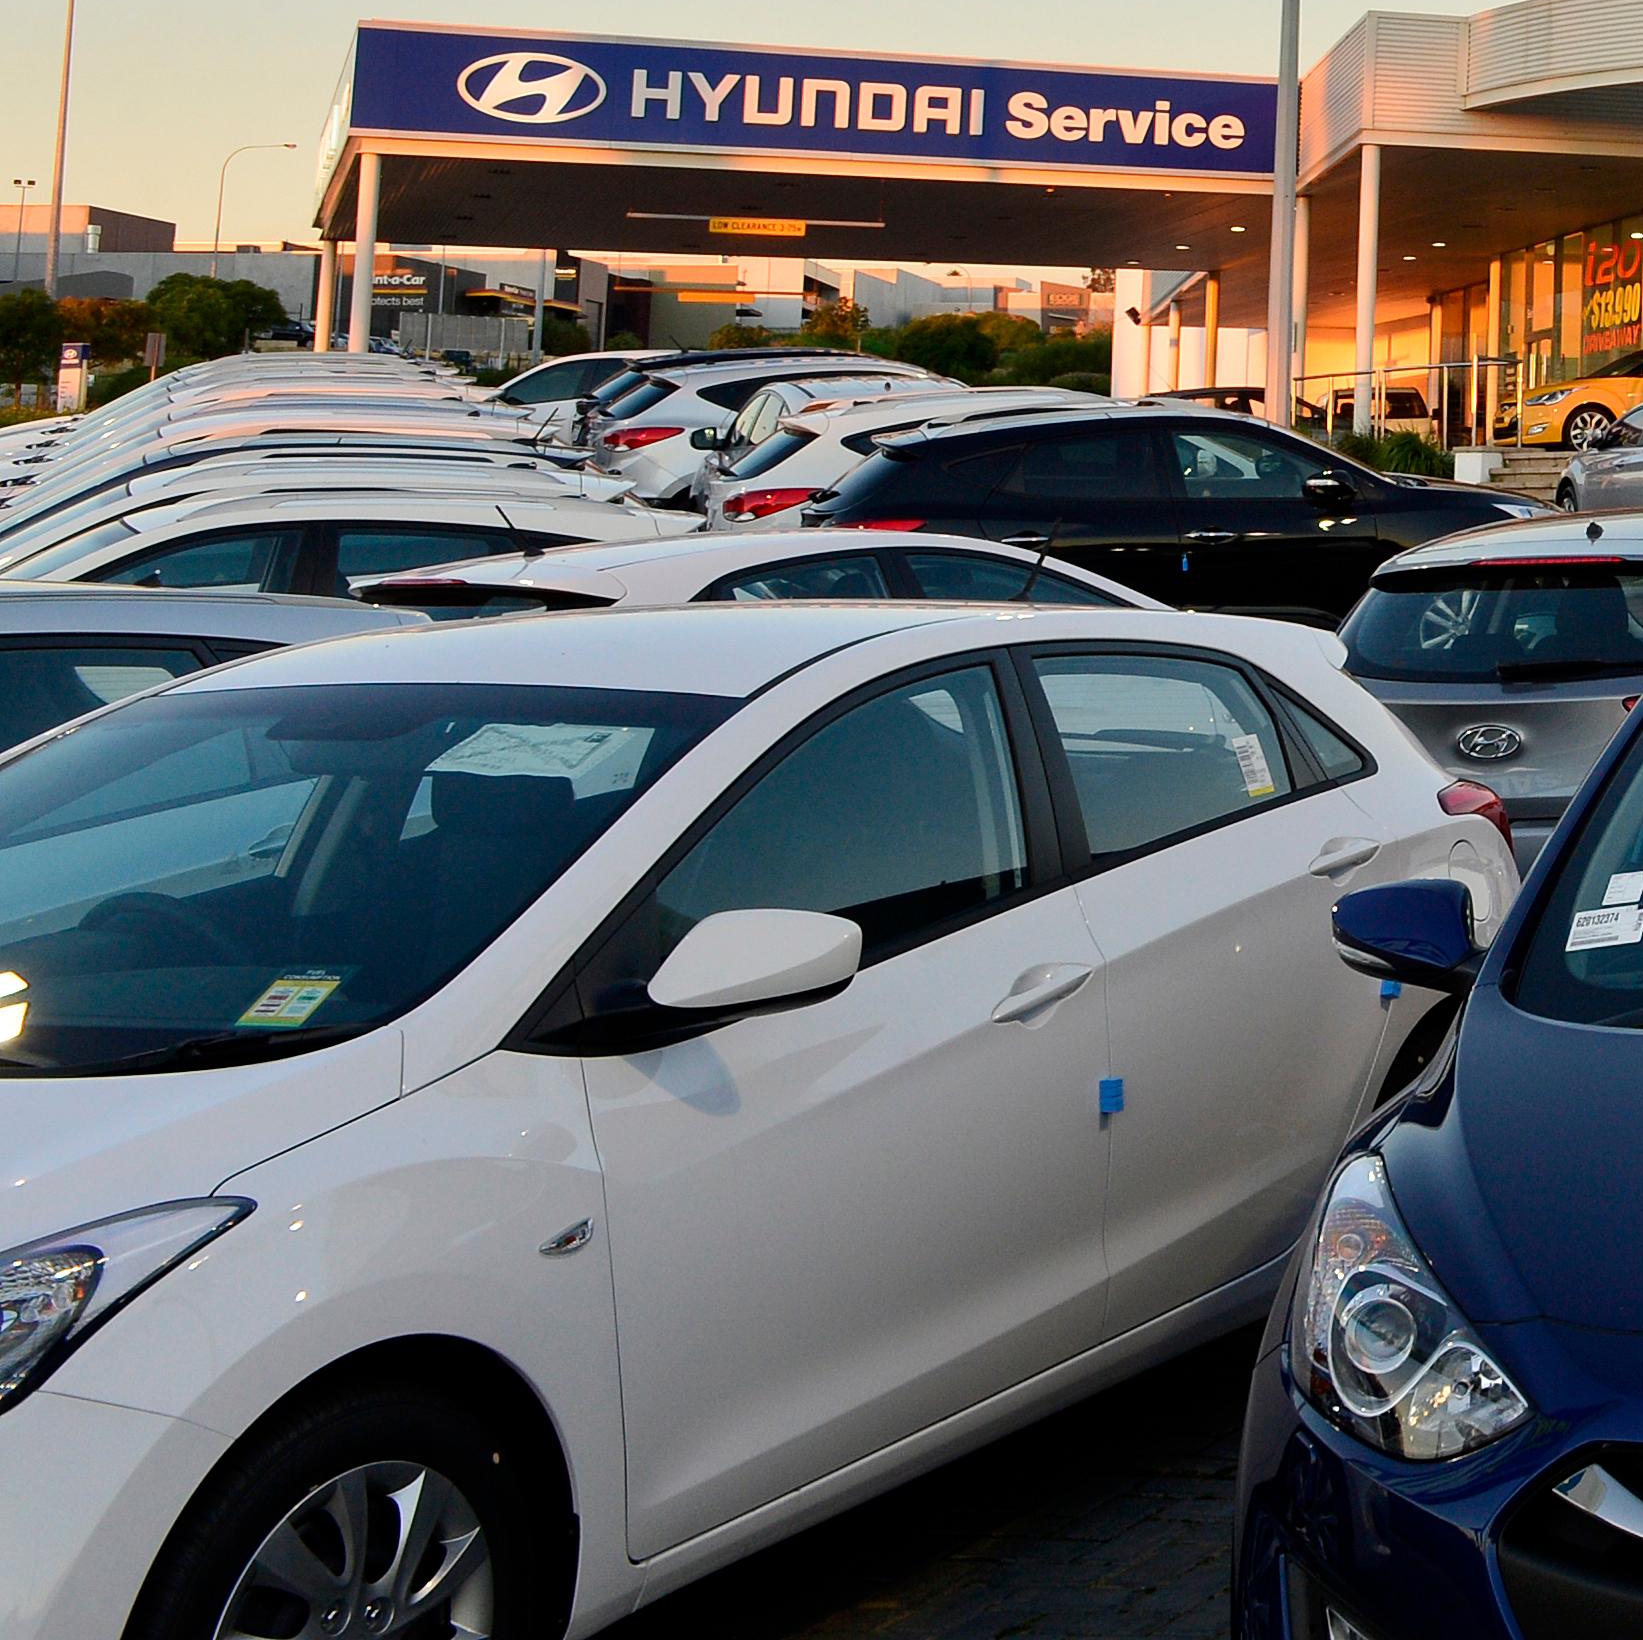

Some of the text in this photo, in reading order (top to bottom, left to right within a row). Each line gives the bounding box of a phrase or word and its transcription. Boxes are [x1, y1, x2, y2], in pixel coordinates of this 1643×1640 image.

[630, 68, 1245, 150] HYUNDAI Service
[732, 221, 776, 231] CLEARANCE
[1585, 240, 1642, 286] i20
